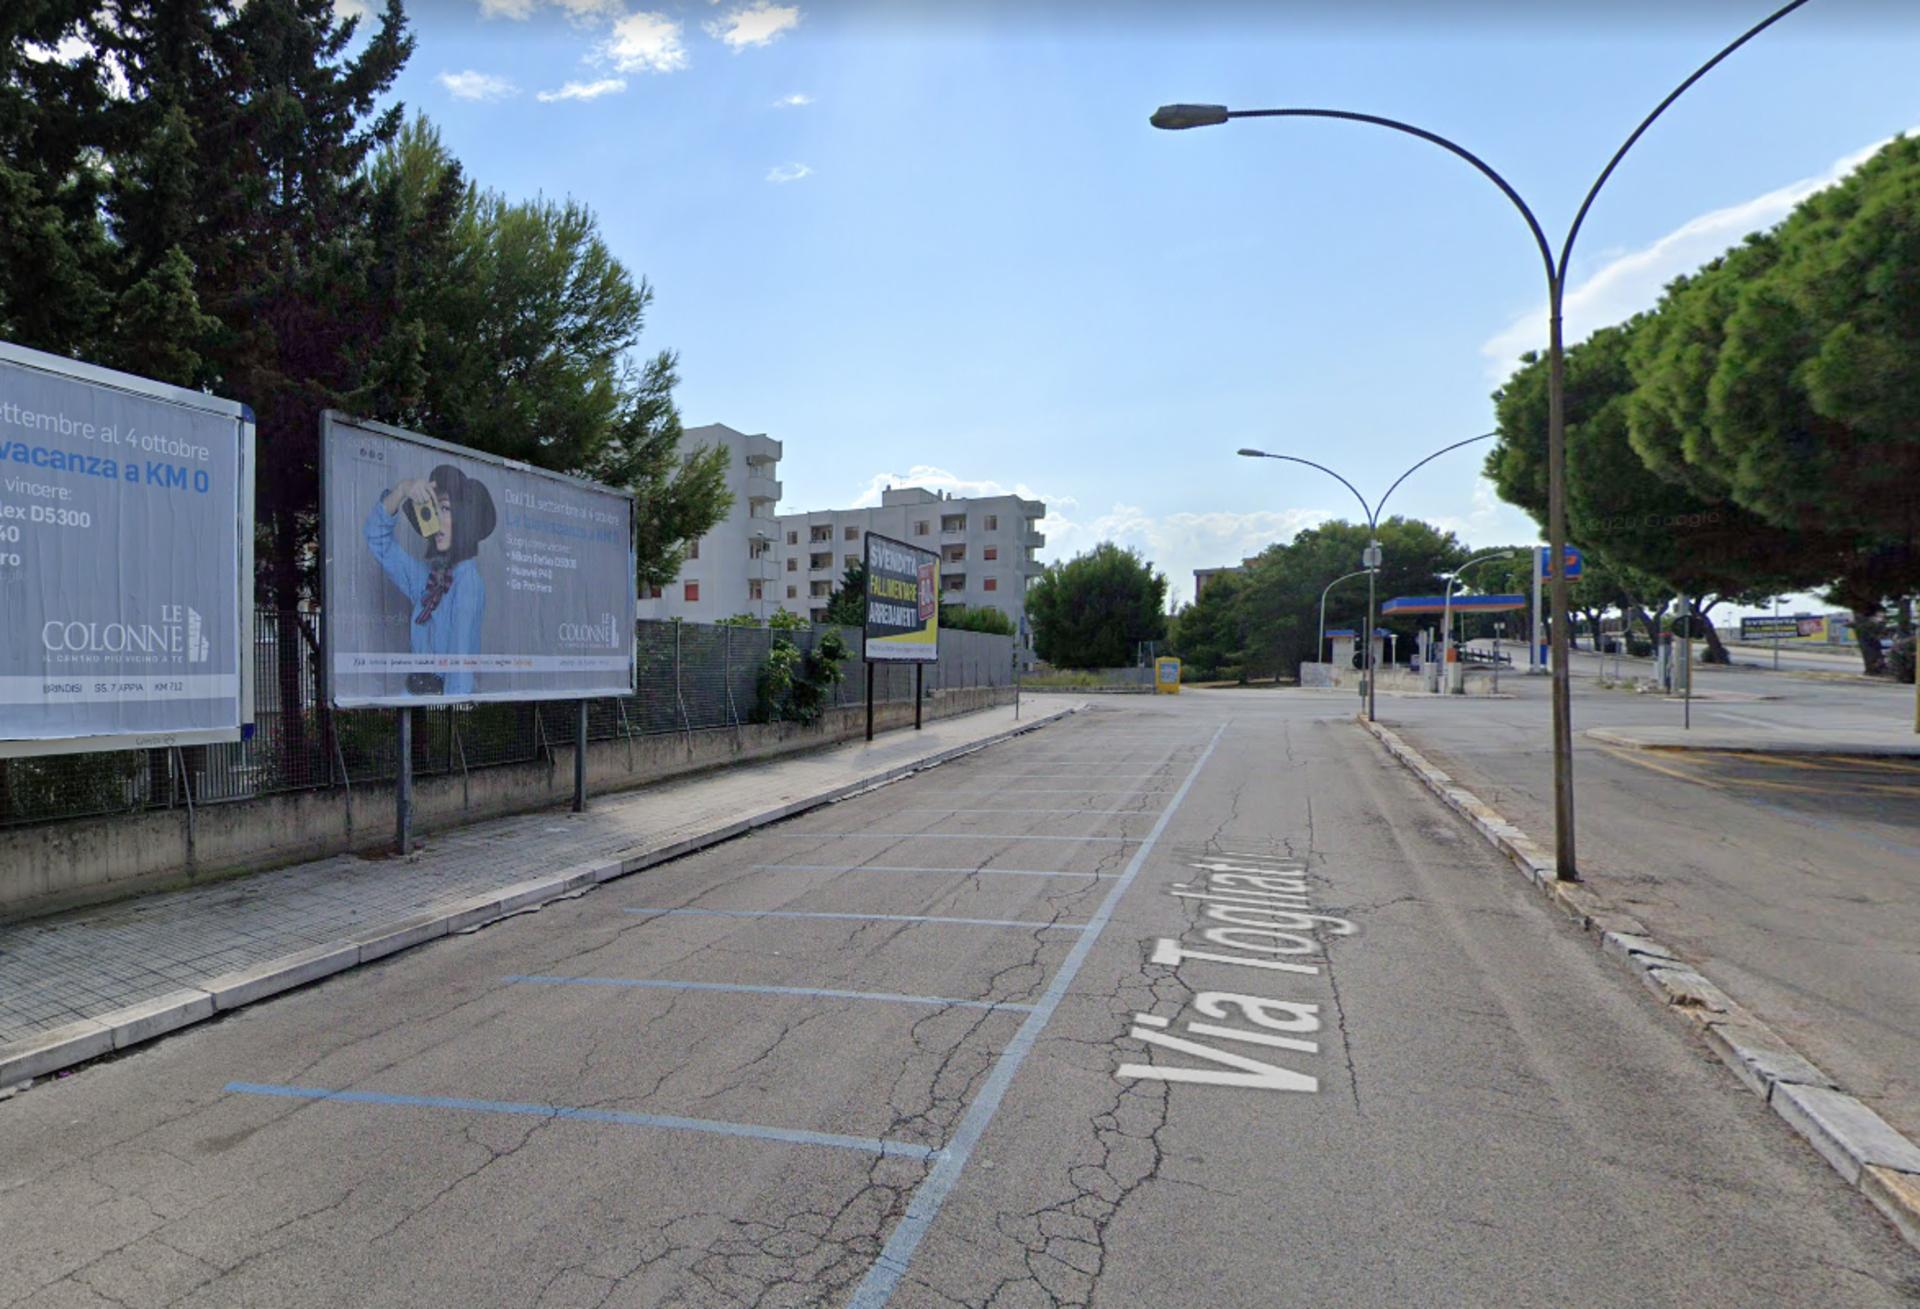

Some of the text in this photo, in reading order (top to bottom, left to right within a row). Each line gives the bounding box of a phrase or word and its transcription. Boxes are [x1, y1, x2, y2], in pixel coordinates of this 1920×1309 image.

[0, 401, 209, 461] ttembre al 4 ottobre
[124, 463, 140, 483] a
[145, 460, 188, 490] KM
[30, 504, 91, 528] D5300
[161, 604, 183, 622] LE
[42, 620, 183, 652] COLONNE
